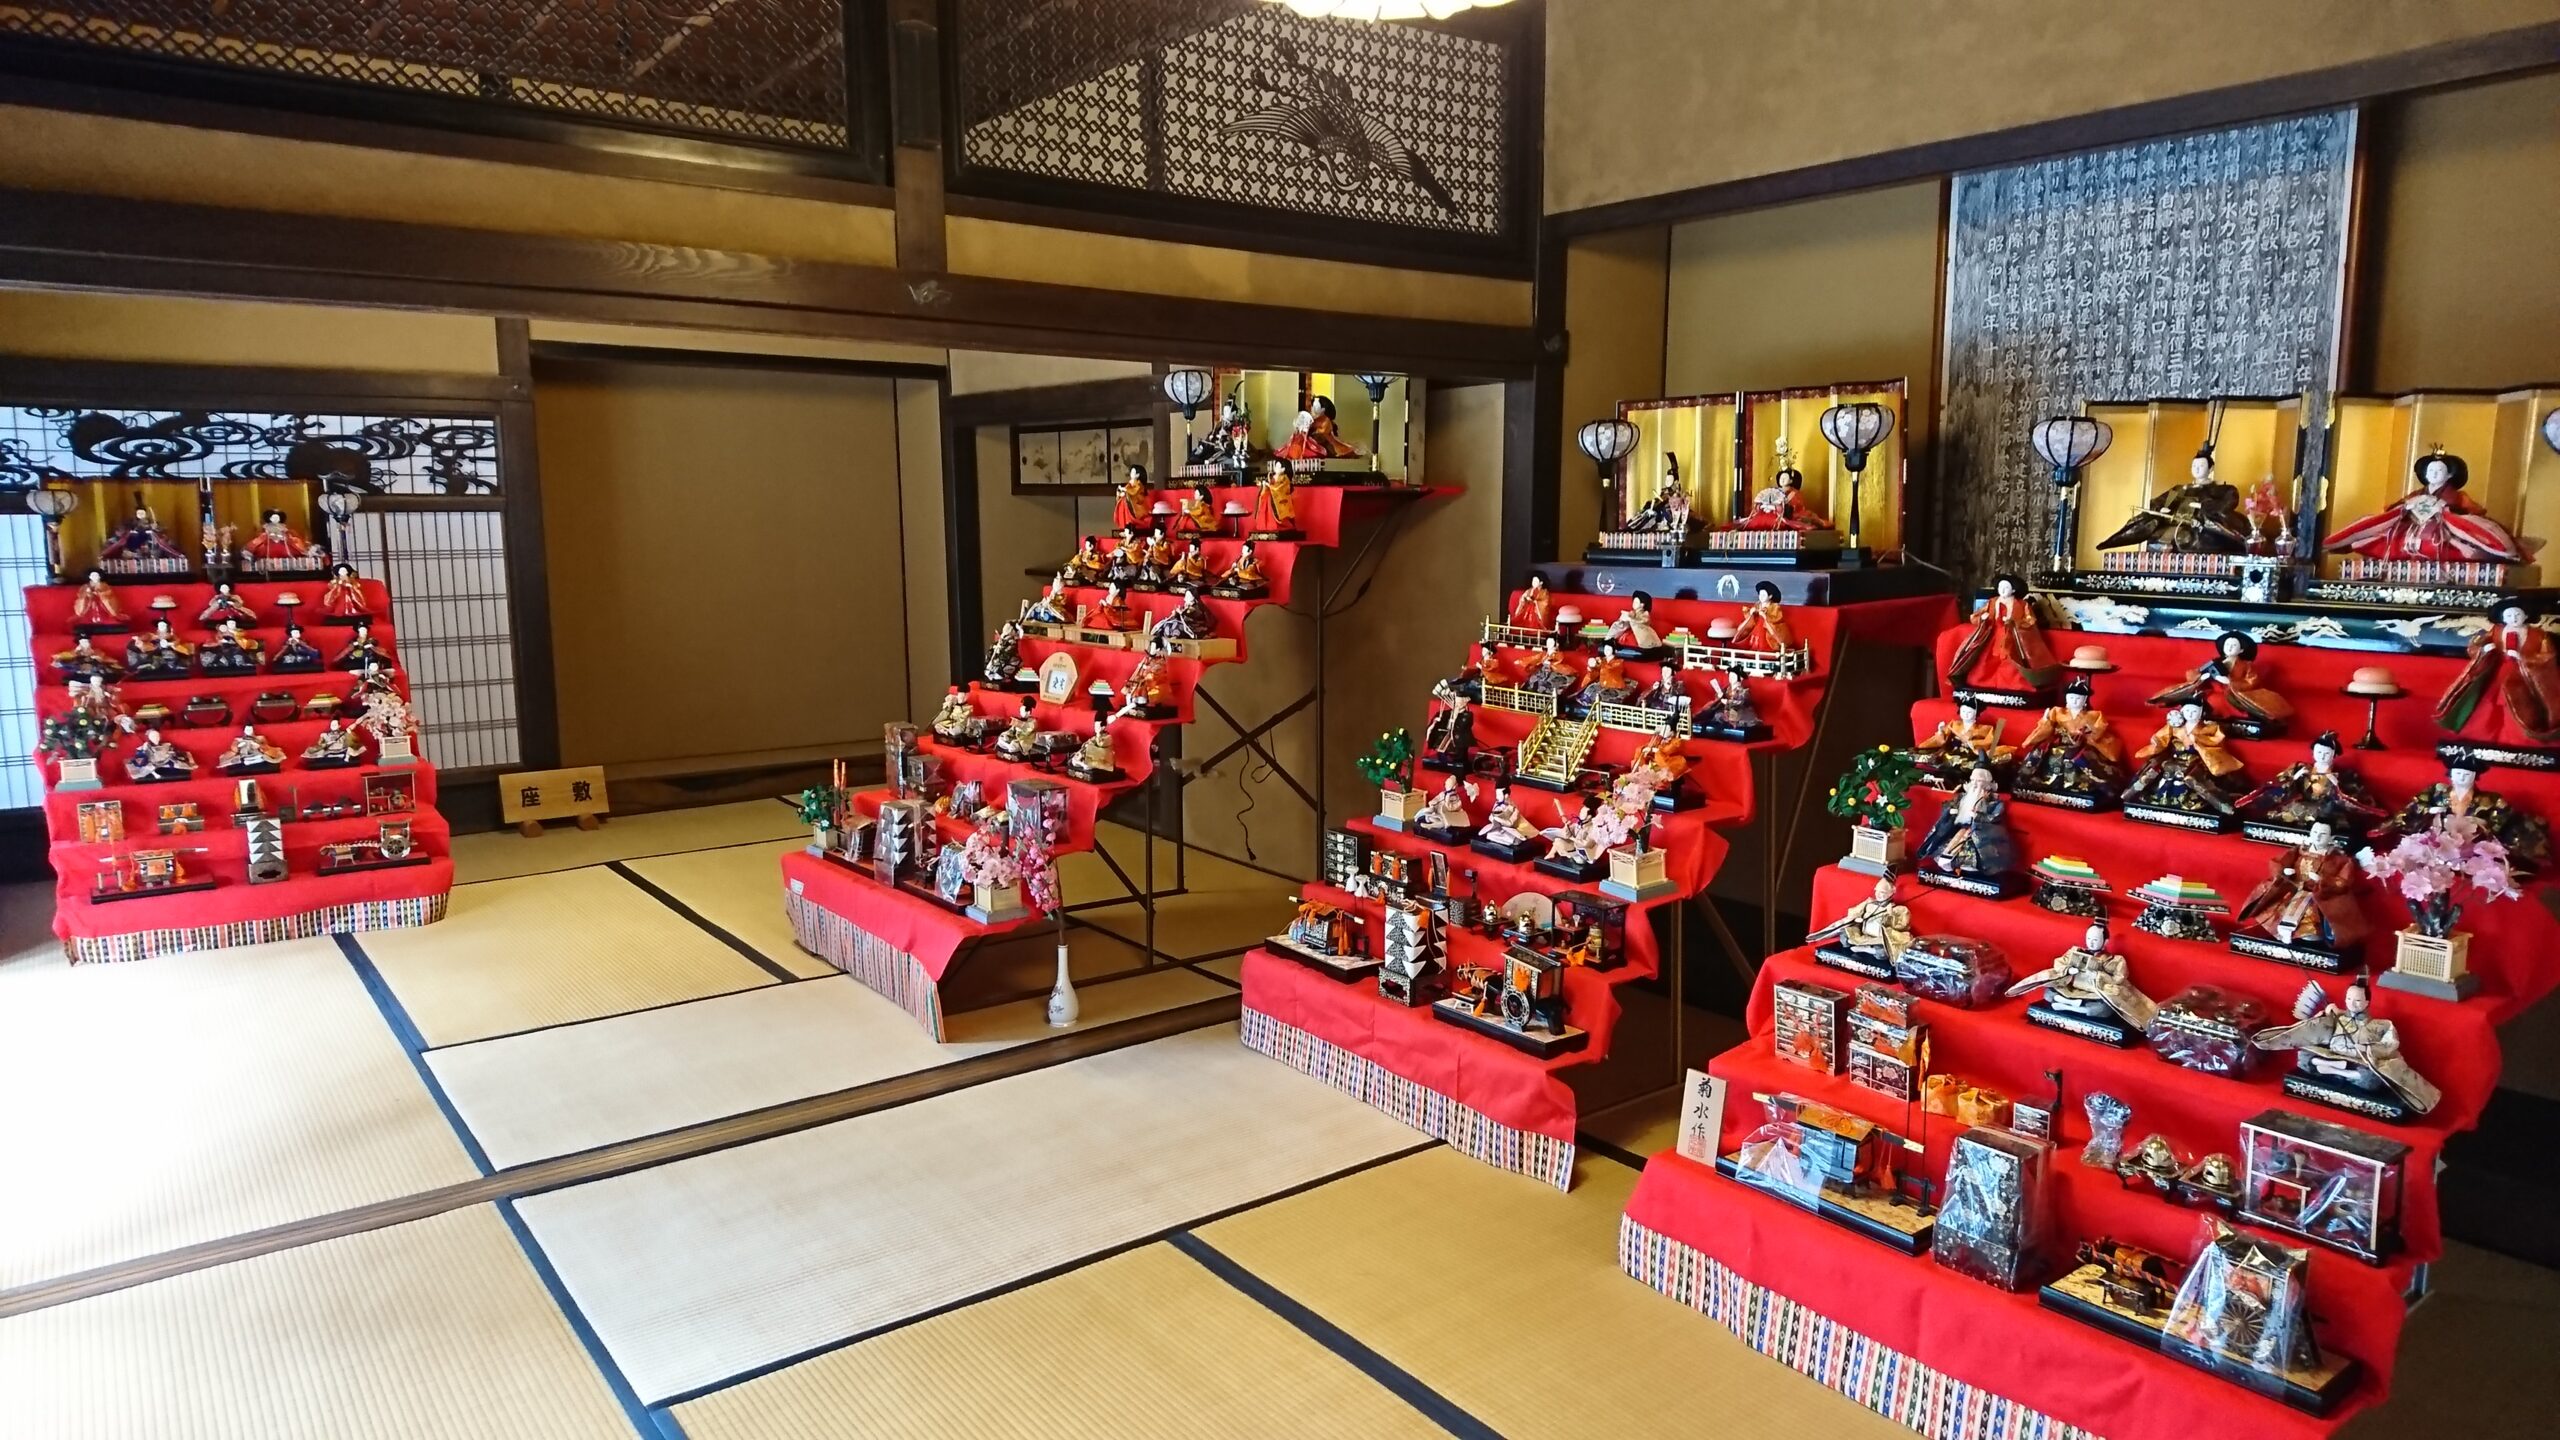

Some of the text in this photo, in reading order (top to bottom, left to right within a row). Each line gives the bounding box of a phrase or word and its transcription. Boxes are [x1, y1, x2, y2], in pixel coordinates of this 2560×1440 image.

[1982, 235, 2004, 385] 昭和七年十月
[521, 780, 592, 808] 座敷
[1691, 1077, 1713, 1140] 菊水作
